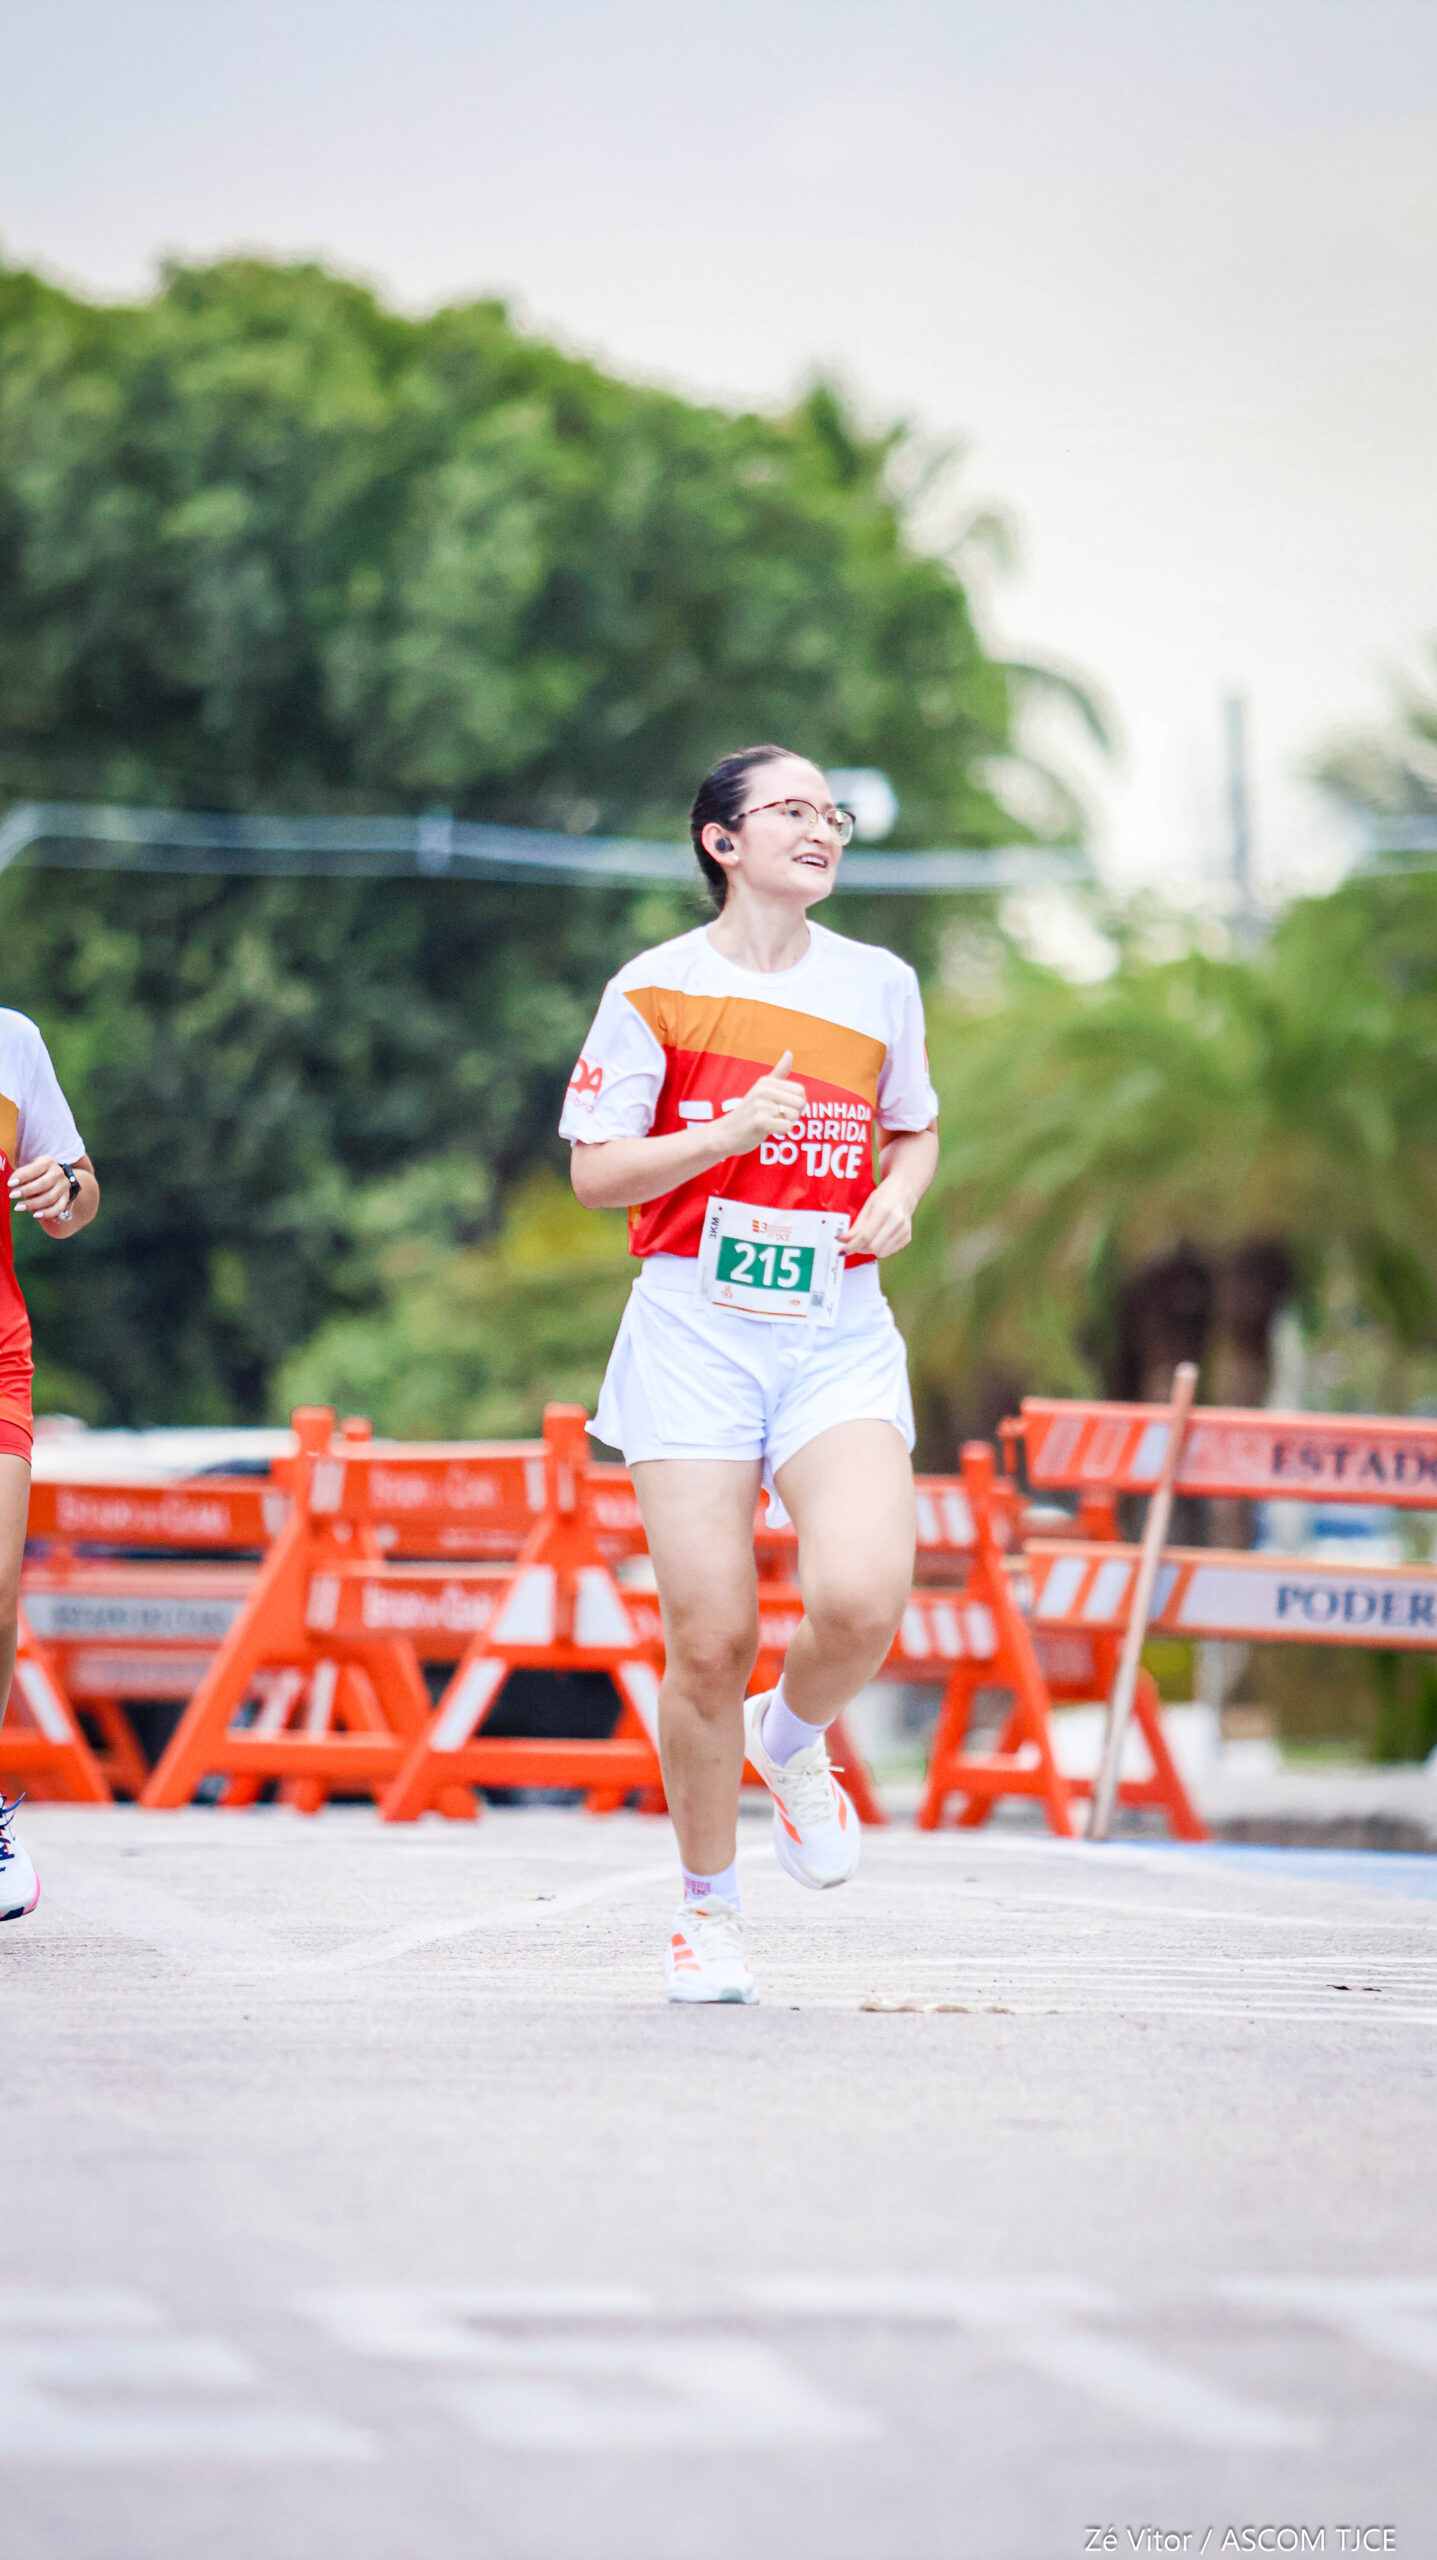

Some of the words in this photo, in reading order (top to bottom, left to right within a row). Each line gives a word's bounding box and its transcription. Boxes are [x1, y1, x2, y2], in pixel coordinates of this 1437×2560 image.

[760, 1141, 799, 1166] DO
[801, 1142, 863, 1179] TJCE
[729, 1241, 801, 1289] 215
